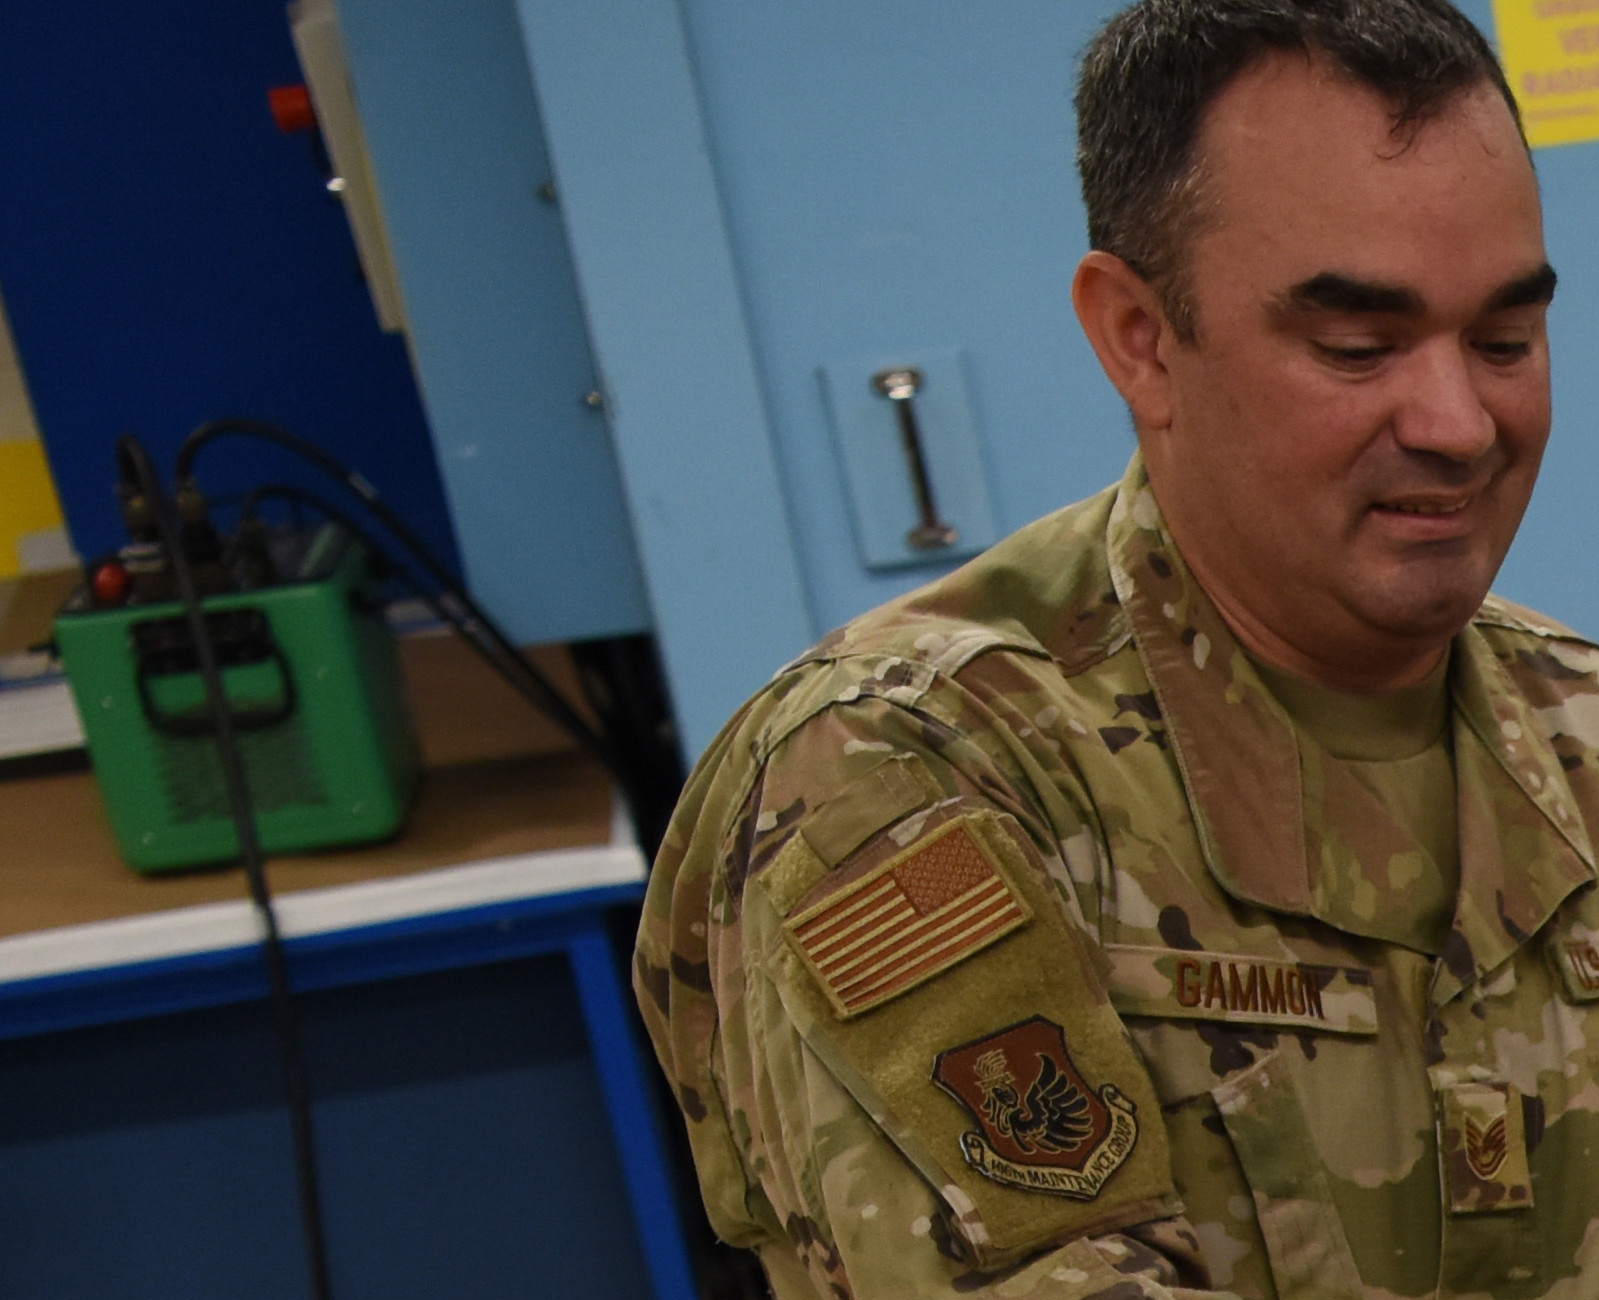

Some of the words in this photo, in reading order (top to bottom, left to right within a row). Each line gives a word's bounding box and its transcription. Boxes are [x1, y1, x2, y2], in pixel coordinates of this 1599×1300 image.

[1176, 958, 1325, 1020] GAMMON
[1027, 1151, 1115, 1191] MAINTENANCE
[1107, 1115, 1132, 1157] GROUP
